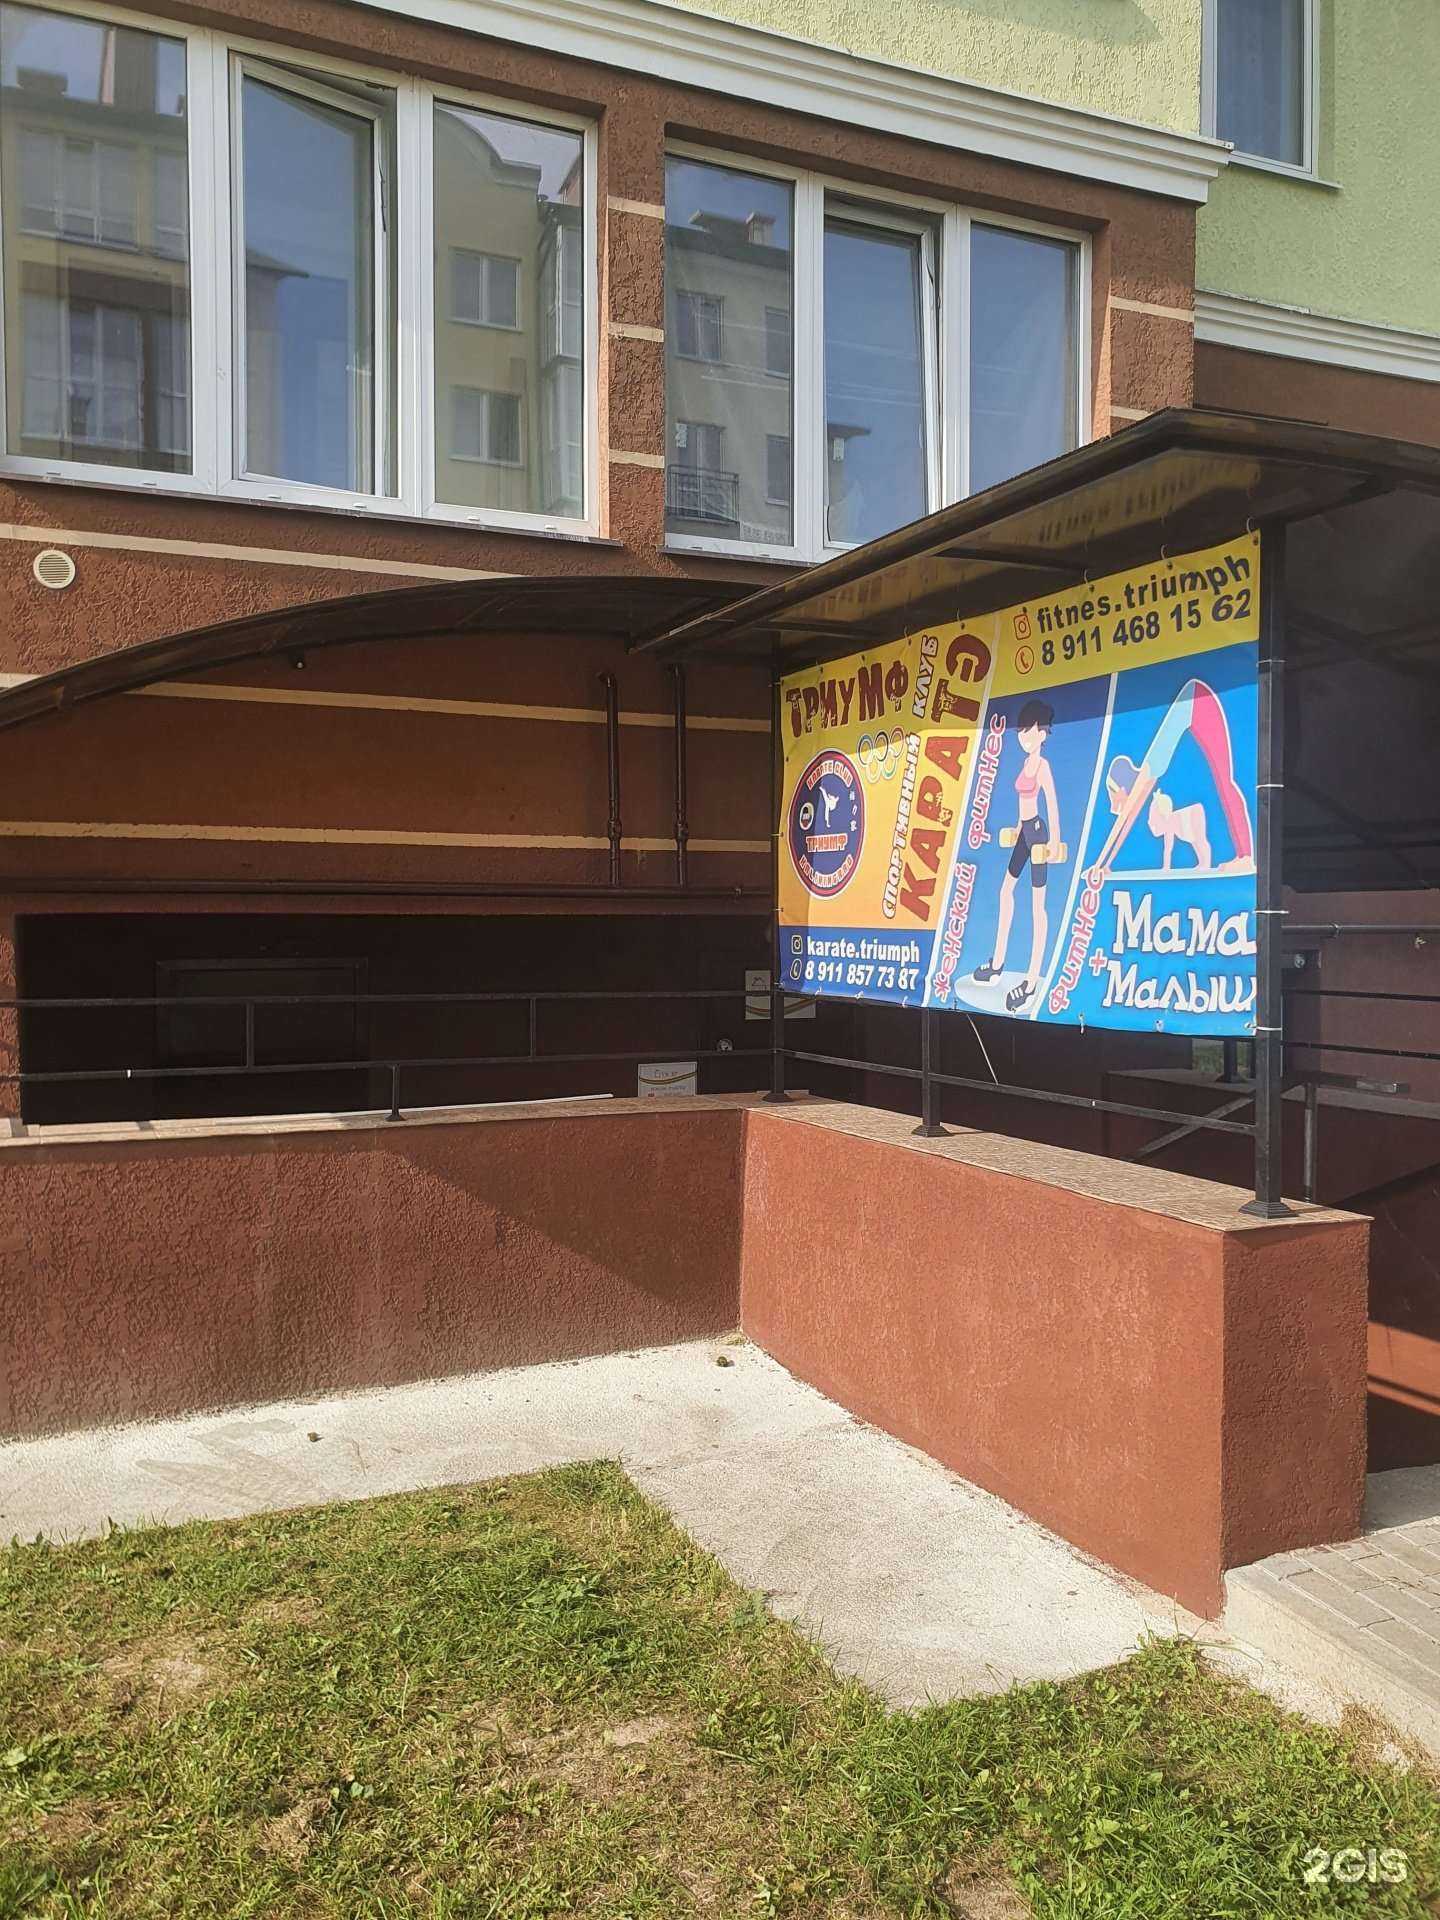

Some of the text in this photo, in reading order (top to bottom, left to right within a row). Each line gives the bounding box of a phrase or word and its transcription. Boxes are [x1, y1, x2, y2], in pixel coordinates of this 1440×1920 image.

[1037, 555, 1250, 634] fitnes.triumph
[1041, 588, 1251, 666] 8 911 468 15 62
[786, 659, 909, 738] ТРИУМФ
[882, 634, 938, 920] СПОРТИВНЫЙ КЛУБ
[900, 634, 992, 922] КАРАТЭ
[933, 713, 1006, 1003] женский фитнес
[807, 936, 920, 966] karate.triumph
[1112, 890, 1257, 957] Мама
[805, 961, 919, 990] 8 911 857 73 87
[1102, 960, 1257, 1013] Малыш
